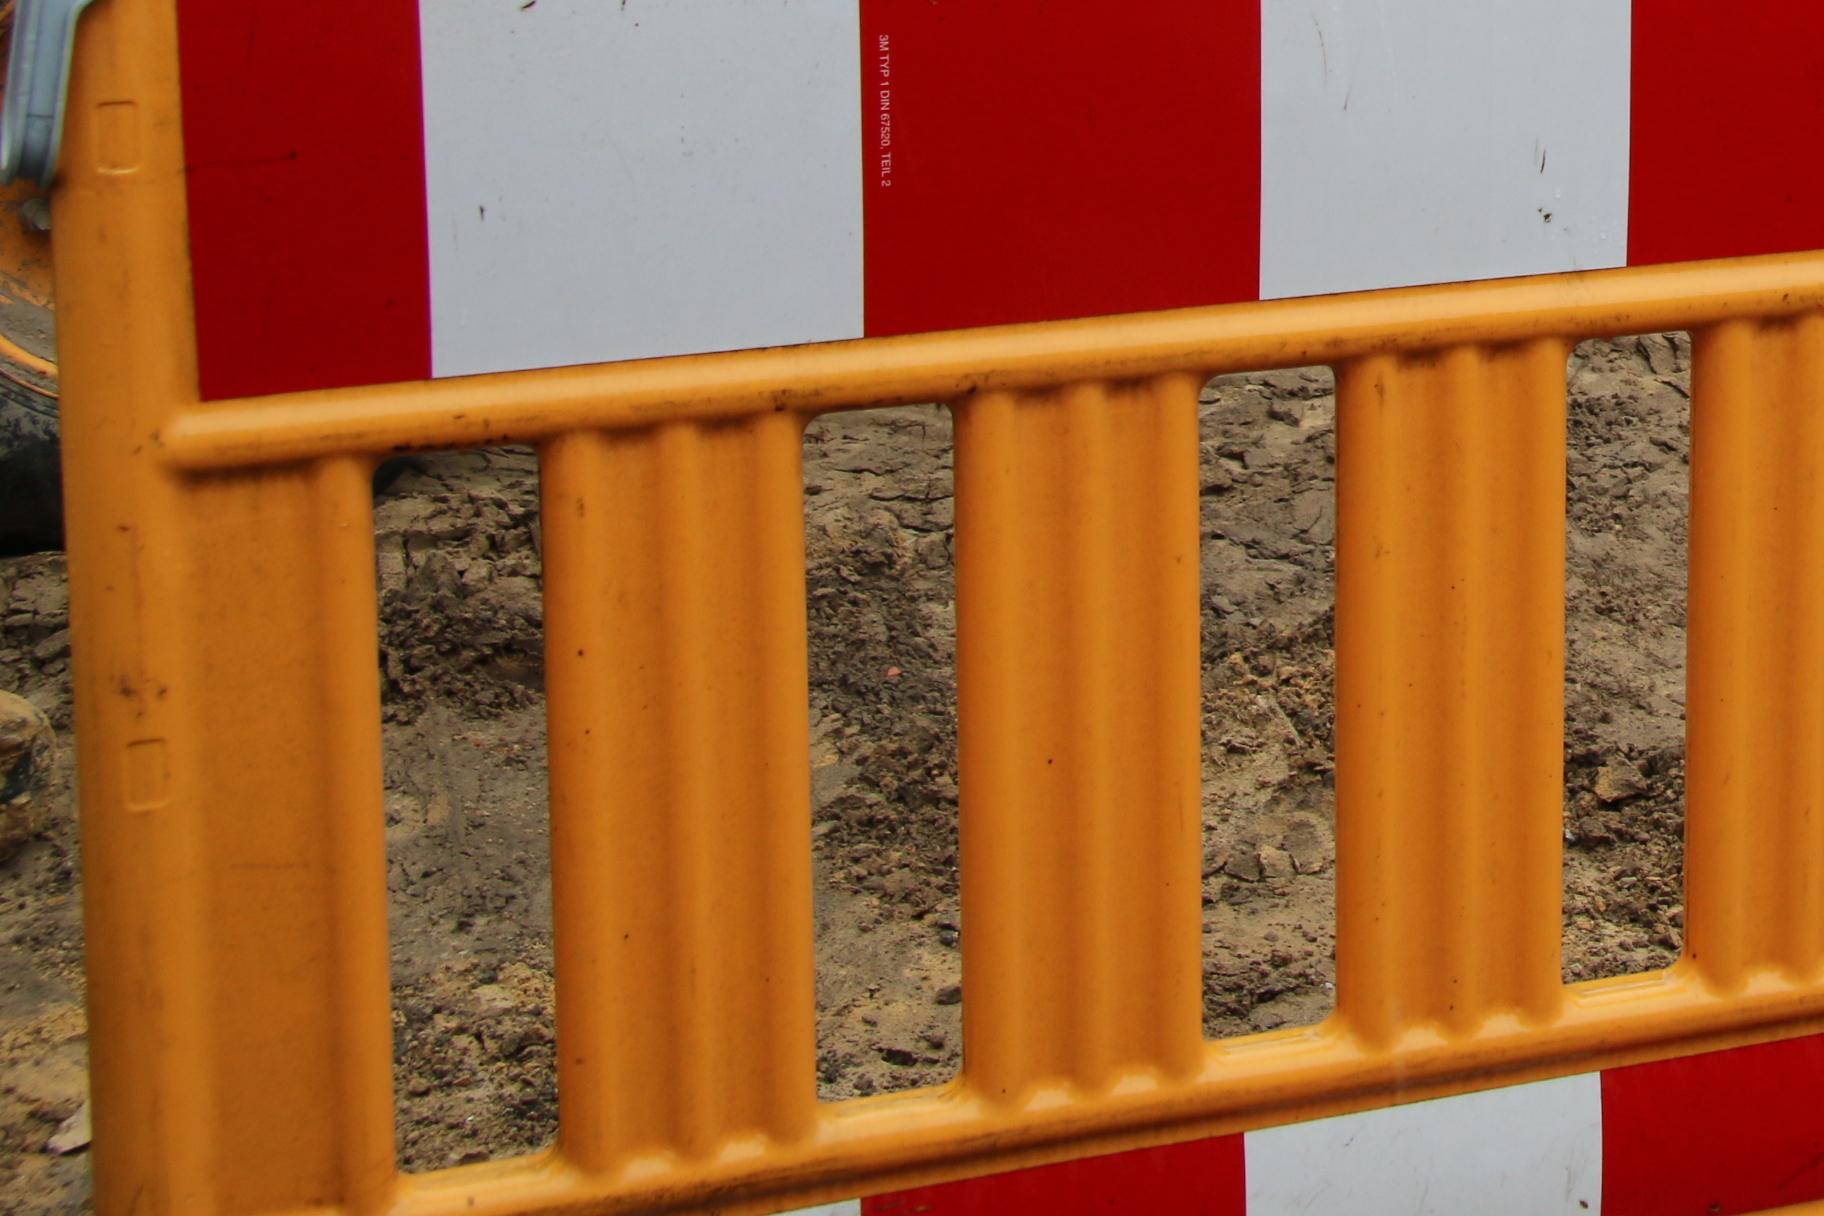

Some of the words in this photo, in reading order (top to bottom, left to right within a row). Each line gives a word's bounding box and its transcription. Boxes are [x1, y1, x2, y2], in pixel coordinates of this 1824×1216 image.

[879, 34, 889, 52] 3M
[879, 54, 890, 78] TYP
[880, 90, 890, 111] DIN
[881, 152, 892, 178] TEIL
